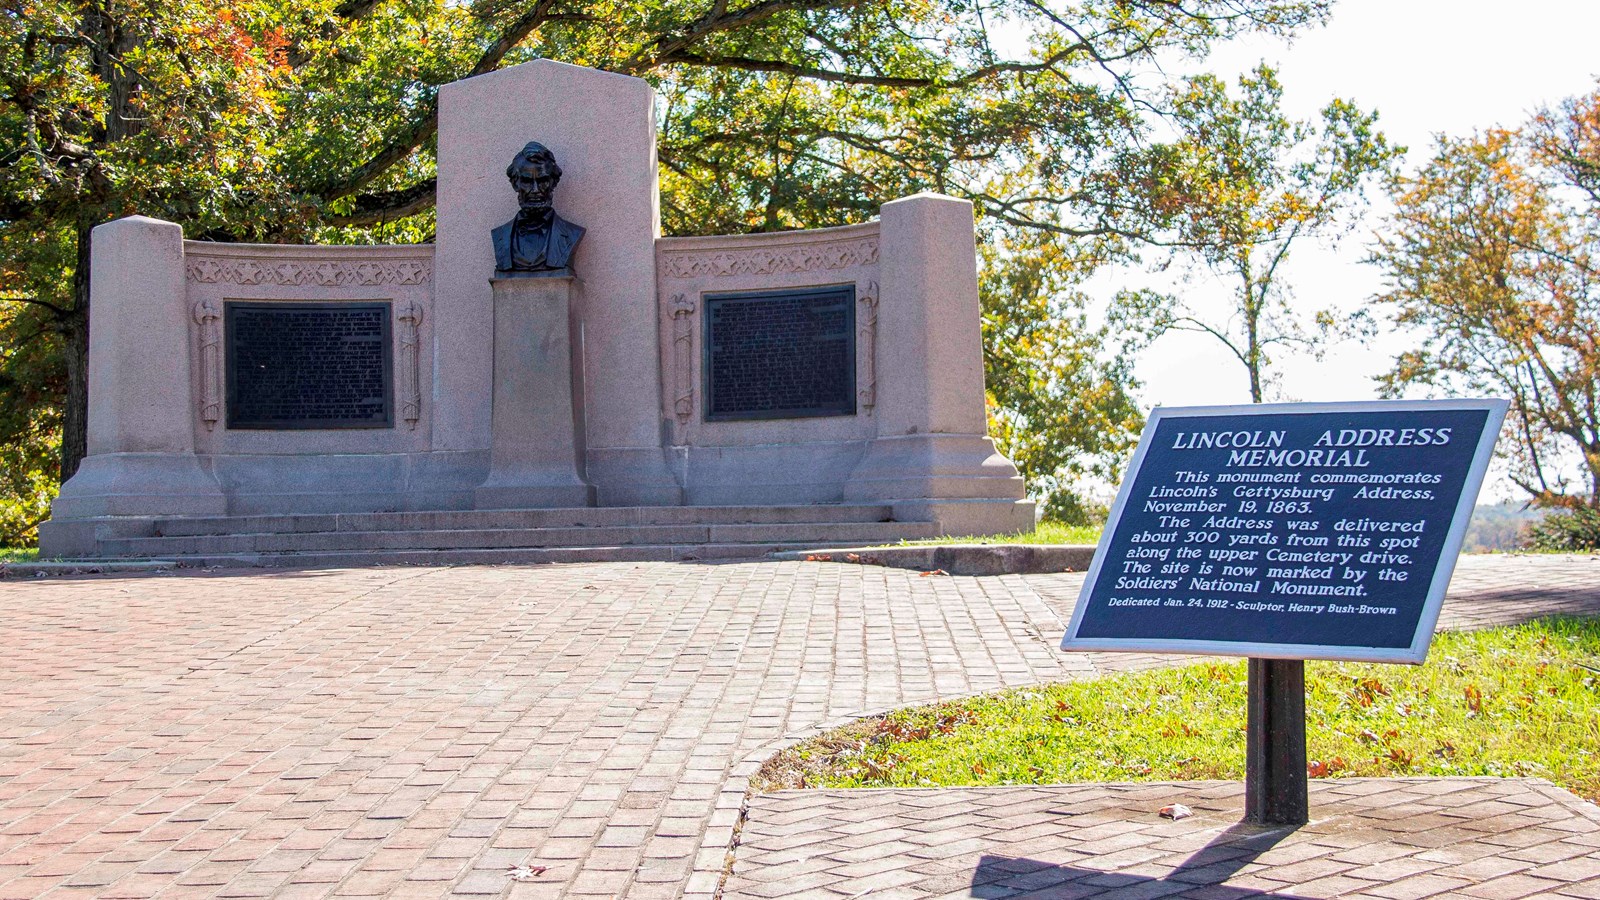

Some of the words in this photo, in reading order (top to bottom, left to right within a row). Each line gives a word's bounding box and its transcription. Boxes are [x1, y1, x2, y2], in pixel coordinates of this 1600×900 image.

[1172, 431, 1286, 448] LINCOLN
[1314, 428, 1451, 446] ADDRESS
[1226, 450, 1369, 466] MEMORIAL
[1176, 471, 1209, 482] This
[1216, 473, 1301, 482] monument
[1311, 473, 1441, 483] commemorates
[1149, 486, 1217, 497] Lincoln's
[1234, 486, 1334, 501] Gettysburg
[1353, 486, 1434, 500] Address,
[1144, 501, 1226, 512] November
[1239, 501, 1257, 513] 19,
[1266, 501, 1312, 513] 1863.
[1159, 516, 1190, 527] The
[1203, 516, 1273, 529] Address
[1288, 521, 1319, 530] was
[1334, 518, 1425, 532] delivered
[1131, 531, 1178, 542] about
[1184, 532, 1219, 542] 300
[1229, 533, 1278, 546] yards
[1287, 534, 1328, 546] from
[1338, 534, 1370, 546] this
[1380, 536, 1420, 550] spot
[1126, 547, 1170, 561] along
[1177, 547, 1201, 558] the
[1209, 550, 1258, 561] upper
[1267, 549, 1353, 565] Cemetery
[1360, 551, 1412, 564] drive.
[1124, 561, 1151, 573] The
[1161, 562, 1189, 573] site
[1199, 562, 1213, 574] is
[1222, 566, 1257, 576] now
[1267, 566, 1333, 578] marked
[1343, 567, 1367, 582] by
[1379, 569, 1408, 581] the
[1115, 577, 1182, 589] Soldiers'
[1189, 578, 1260, 592] National
[1271, 582, 1367, 596] Monument.
[1109, 597, 1160, 606] Dedicated
[1164, 598, 1184, 606] Jan.
[1207, 600, 1228, 608] 1912
[1236, 601, 1284, 612] Sculptor,
[1288, 604, 1324, 613] Henry
[1328, 604, 1396, 614] Bush-Brown
